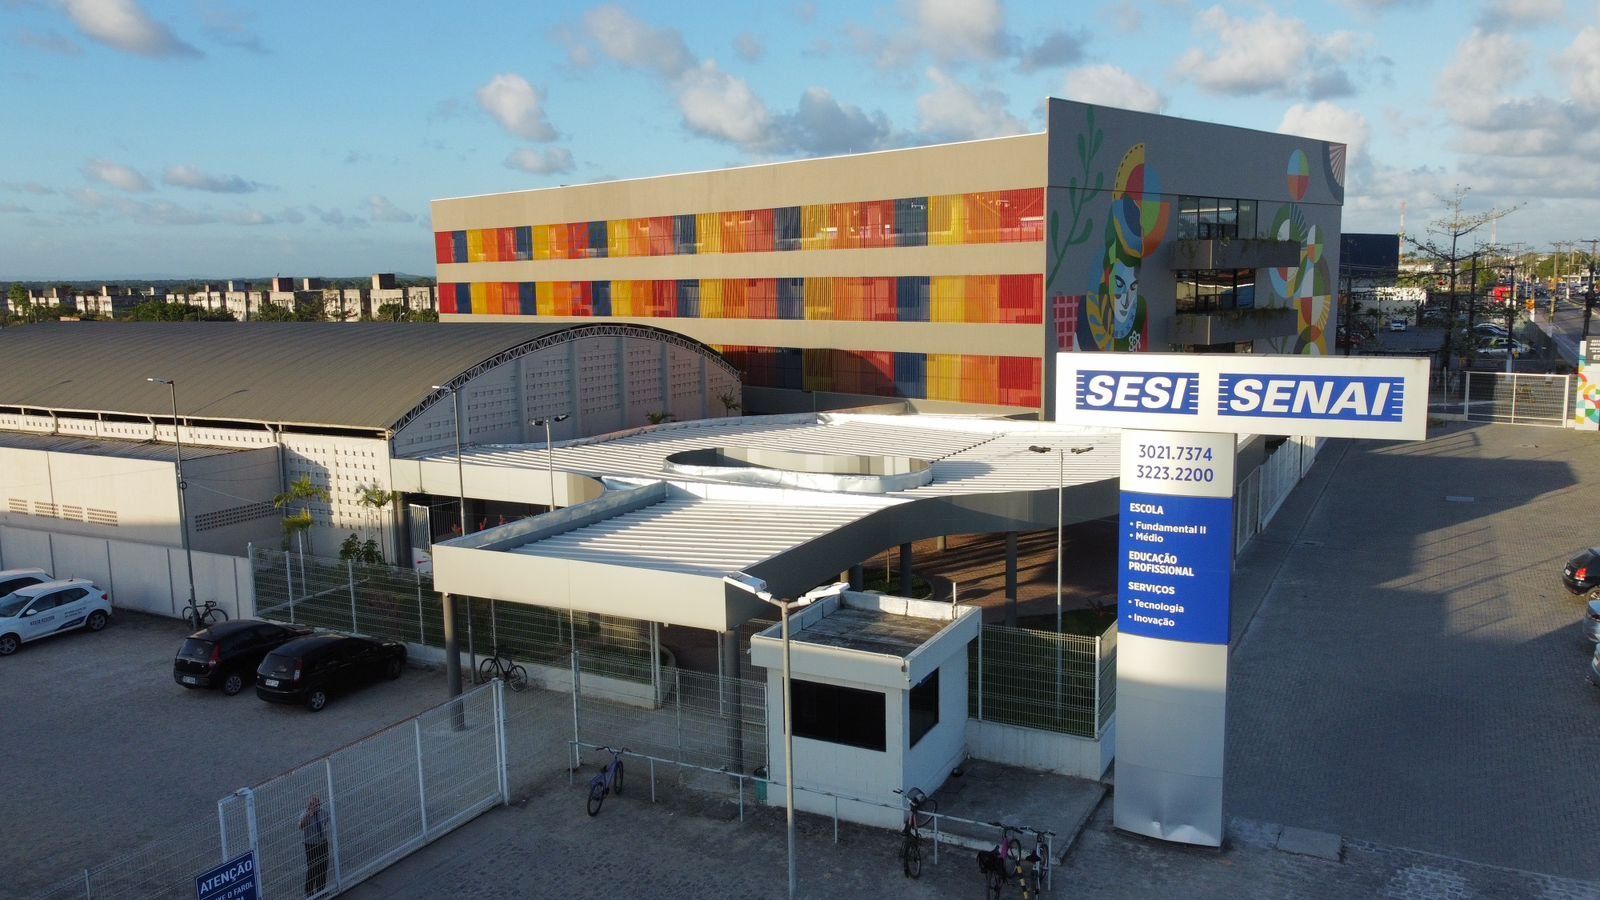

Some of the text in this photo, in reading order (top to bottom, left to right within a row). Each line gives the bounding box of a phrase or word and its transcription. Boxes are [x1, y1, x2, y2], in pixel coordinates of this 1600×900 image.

[1086, 375, 1390, 416] SESI SENAI
[1138, 444, 1212, 461] 3021.7374
[1136, 464, 1214, 482] 3223.2200
[1129, 502, 1164, 515] ESCOLA
[1135, 520, 1206, 535] Fundamental II
[1135, 531, 1164, 543] Médio
[1128, 550, 1178, 565] EDUCAÇÃO
[1128, 561, 1195, 577] PROFISSIONAL
[1127, 581, 1175, 595] SERVIÇOS
[1133, 598, 1184, 613] Tecnologia
[1133, 613, 1175, 627] Inovação
[199, 860, 253, 895] ATENÇÃO
[233, 881, 255, 896] FAROL
